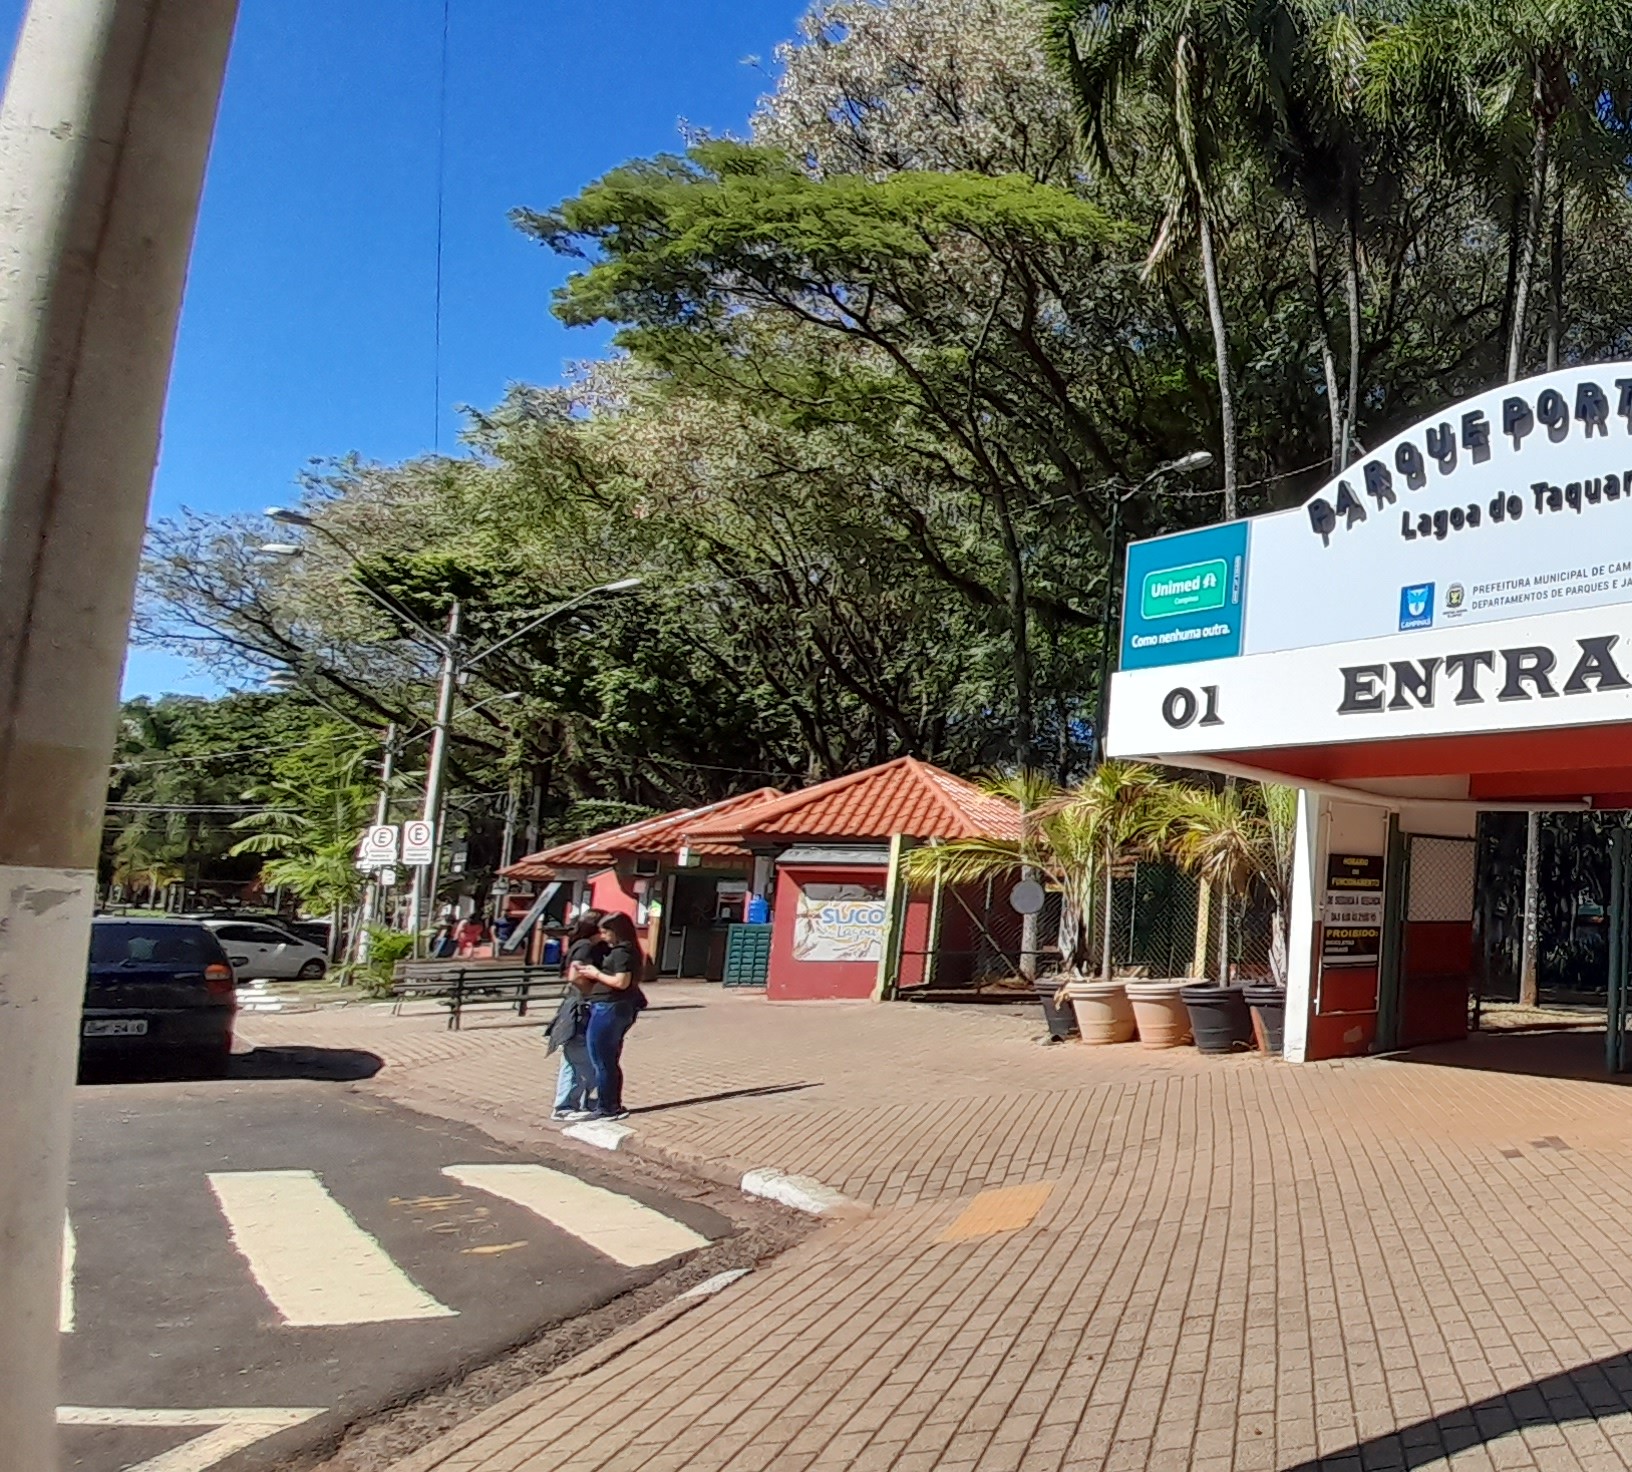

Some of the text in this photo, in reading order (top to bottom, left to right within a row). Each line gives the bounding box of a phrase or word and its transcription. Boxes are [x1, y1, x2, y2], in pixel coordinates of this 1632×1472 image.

[1308, 409, 1490, 541] PARQUE
[1401, 503, 1481, 541] Lagoa
[1489, 491, 1523, 523] do
[1151, 575, 1201, 598] Unimed
[1471, 590, 1549, 610] DEPARTAMENTOS
[1550, 587, 1564, 599] DE
[1565, 579, 1610, 597] PARQUES
[1612, 579, 1618, 589] E
[1472, 577, 1531, 596] PREFEITURA
[1533, 568, 1589, 586] MUNICIPAL
[1591, 565, 1605, 577] DE
[1131, 634, 1158, 648] Como
[1158, 628, 1202, 645] nenhuma
[1160, 684, 1225, 731] 01
[822, 908, 885, 925] SUCO
